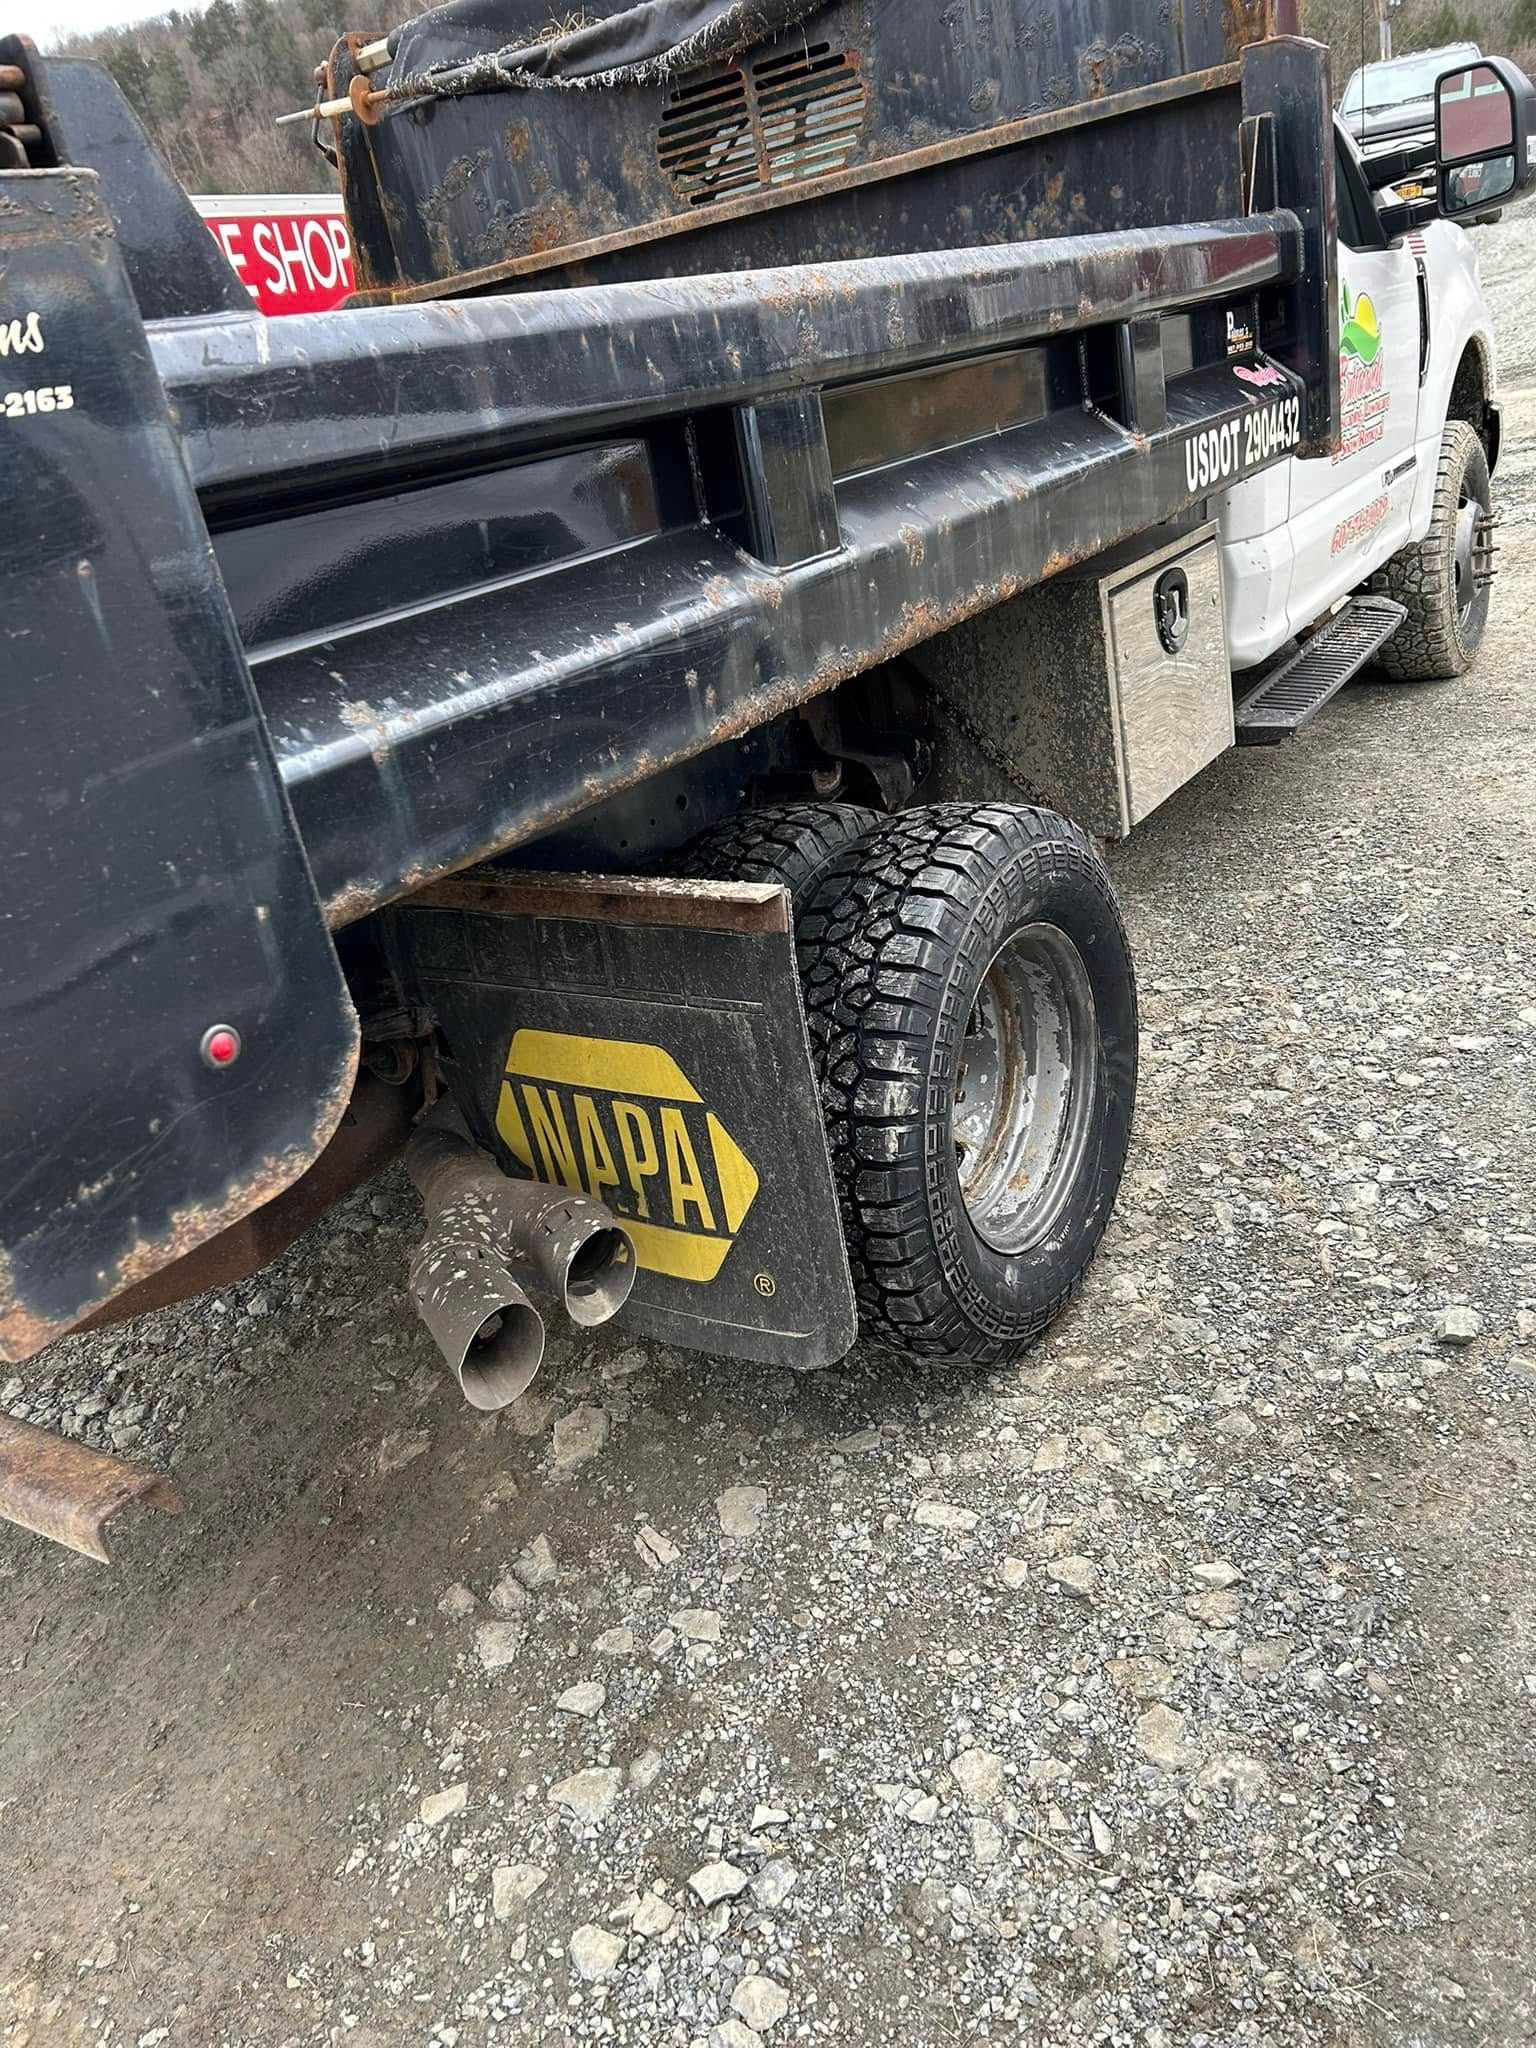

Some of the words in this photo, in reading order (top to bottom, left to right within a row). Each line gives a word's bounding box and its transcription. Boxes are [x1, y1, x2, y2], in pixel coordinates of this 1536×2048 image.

[207, 224, 259, 297] E
[252, 219, 352, 296] SHOP
[1185, 418, 1241, 492] USDOT
[1244, 396, 1300, 466] 2904432
[521, 1083, 717, 1232] NAPA
